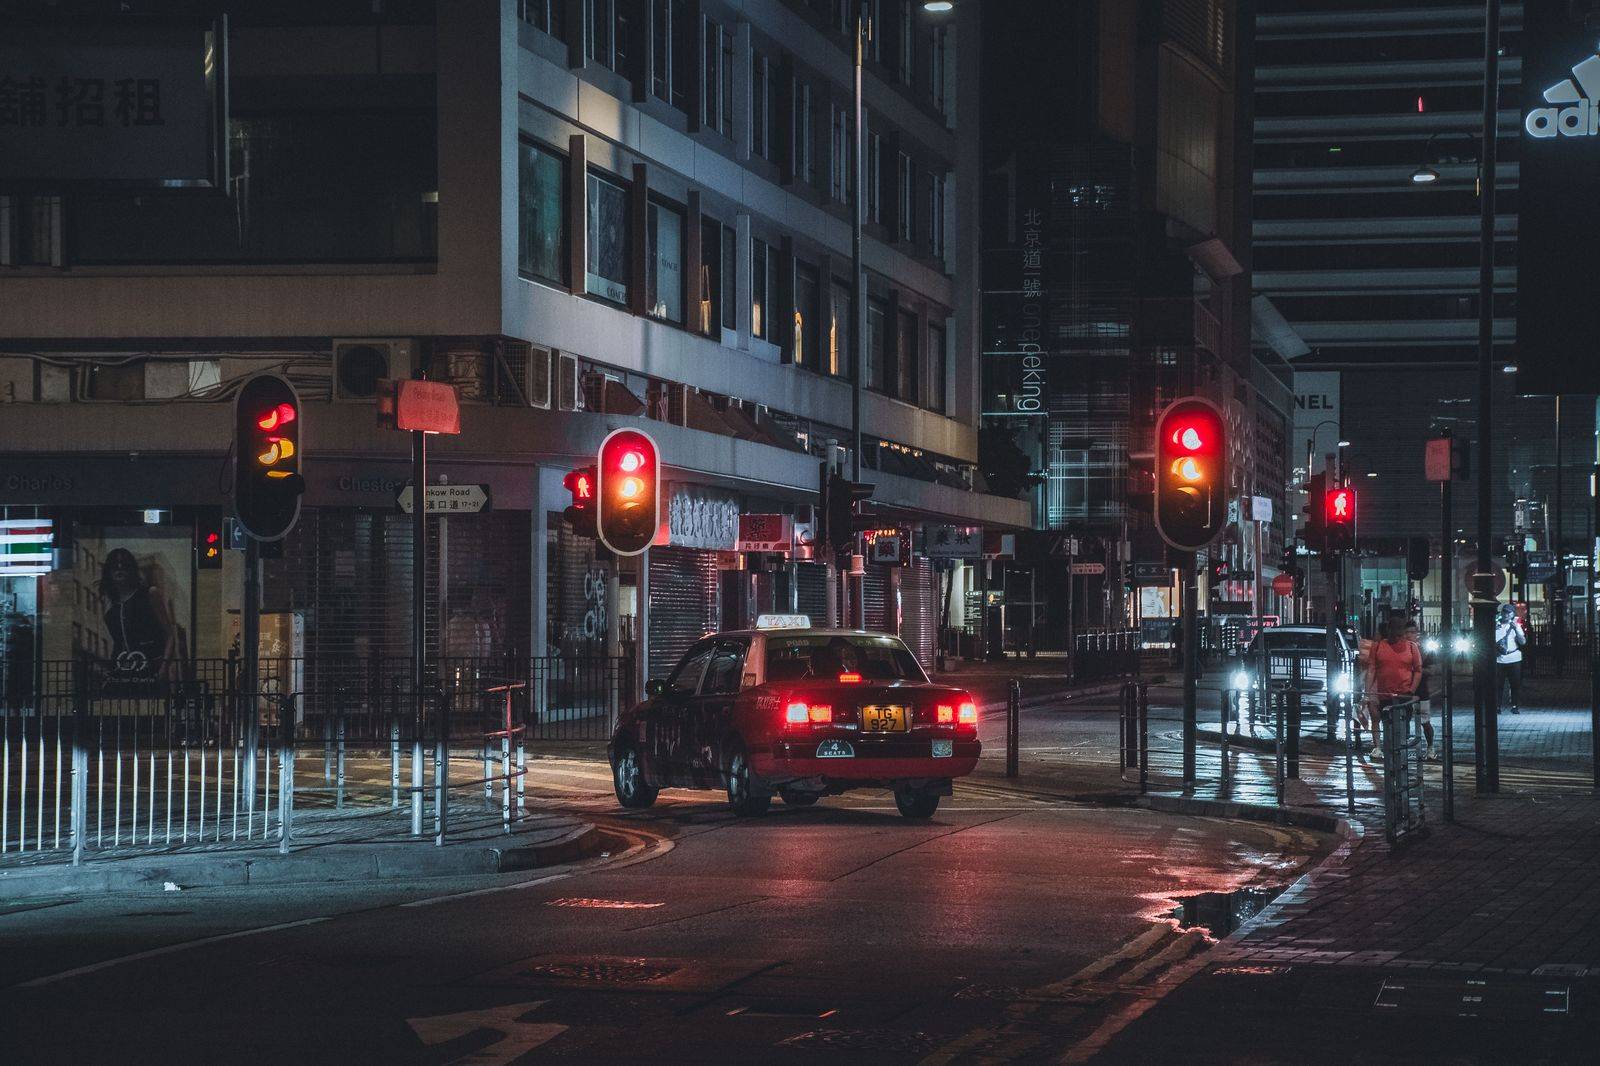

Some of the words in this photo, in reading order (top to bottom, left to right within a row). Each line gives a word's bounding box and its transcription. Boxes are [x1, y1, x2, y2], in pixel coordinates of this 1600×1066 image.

[1525, 97, 1600, 137] adi
[1023, 208, 1041, 298] 北京道一號
[1294, 394, 1333, 409] NEL
[8, 475, 73, 490] Charles
[426, 488, 447, 496] nkow
[449, 488, 470, 496] Road
[426, 501, 458, 509] 漢口道
[766, 616, 805, 626] TAXI
[1247, 619, 1274, 628] Suway
[875, 708, 892, 719] TG
[870, 718, 897, 730] 927
[831, 743, 839, 751] 4
